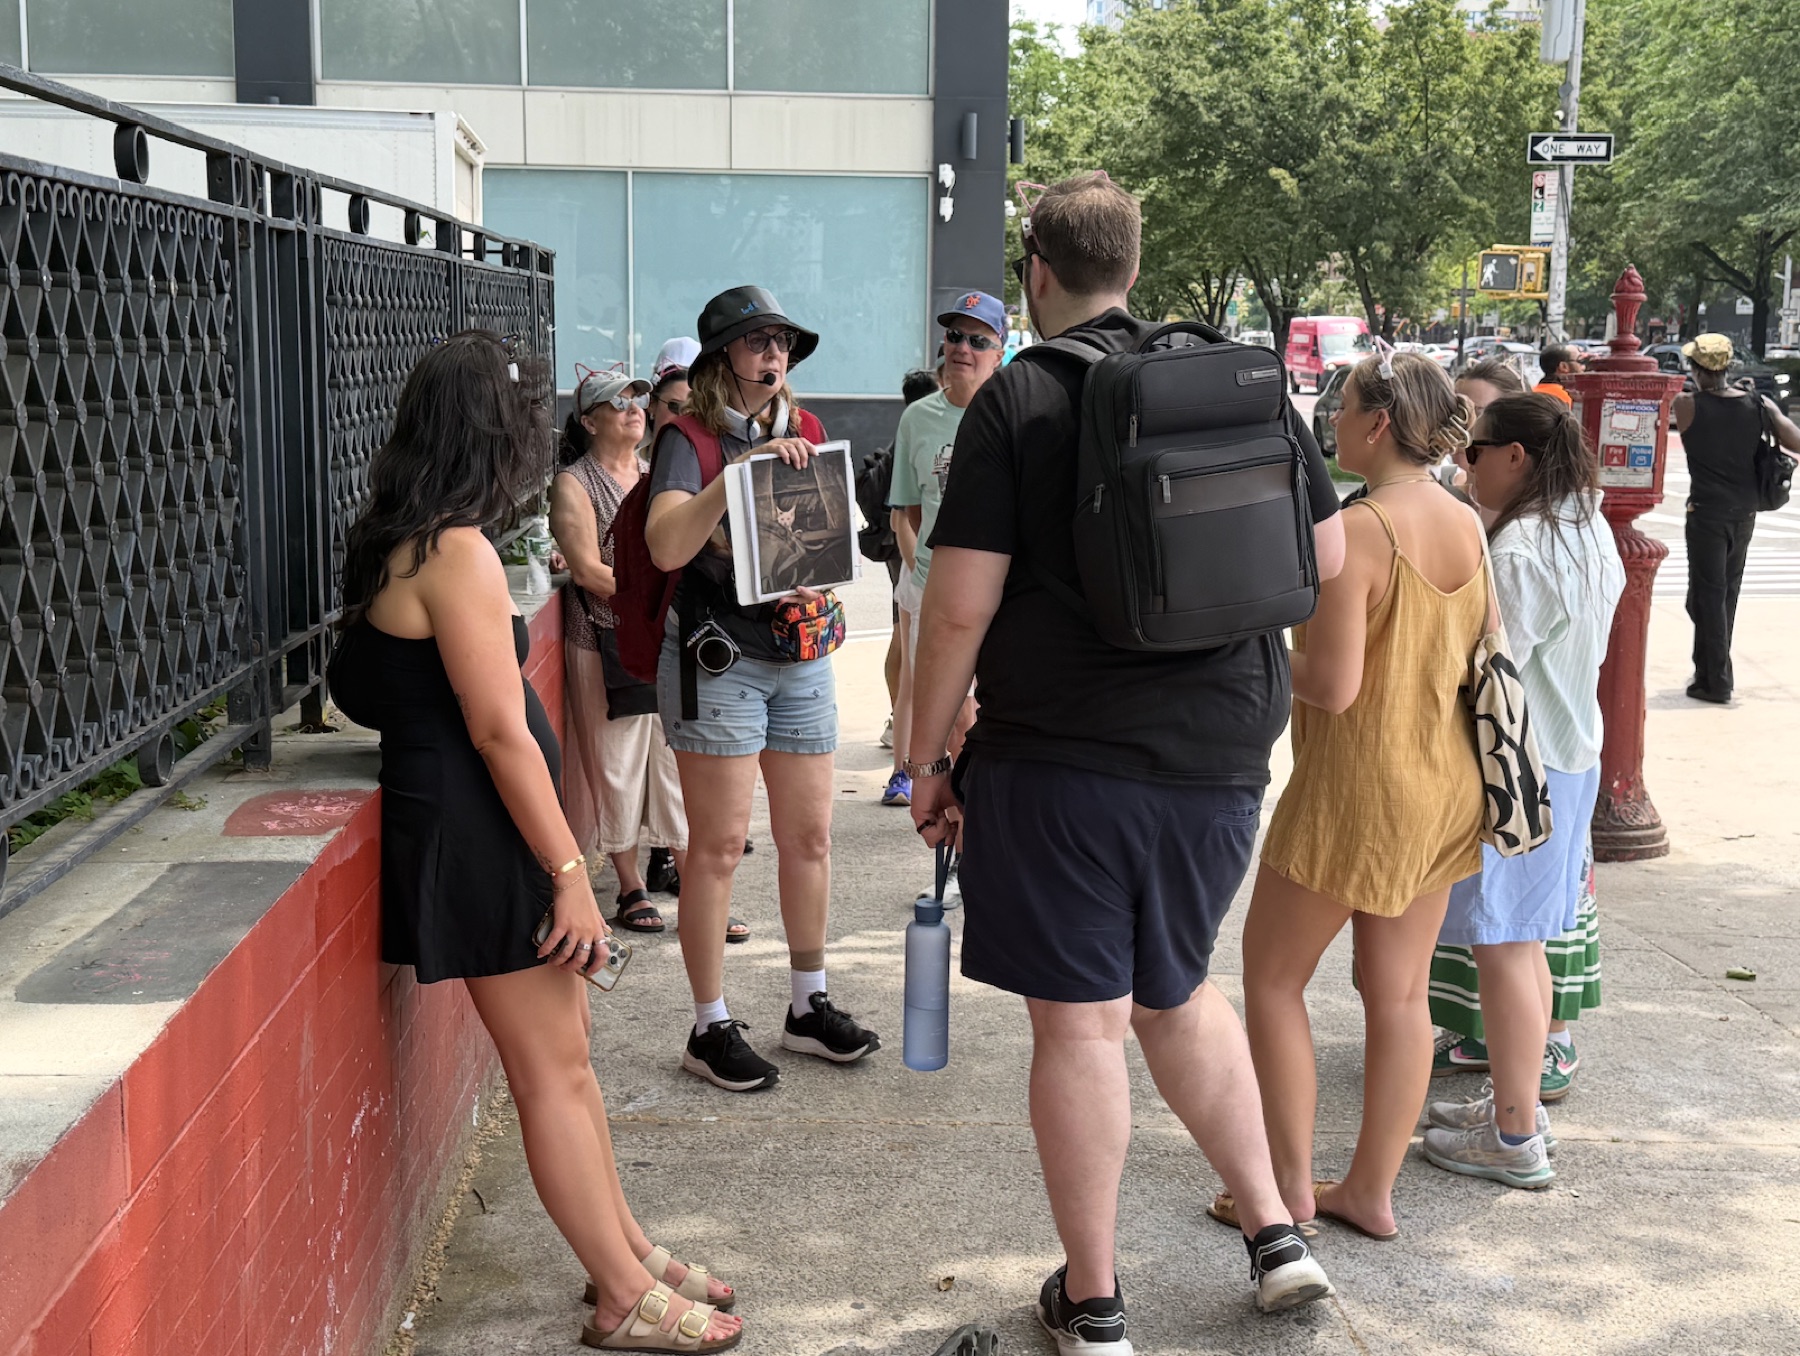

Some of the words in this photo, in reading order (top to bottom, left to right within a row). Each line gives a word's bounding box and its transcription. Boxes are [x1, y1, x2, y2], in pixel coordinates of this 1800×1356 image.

[1541, 143, 1565, 154] ONE
[1576, 143, 1601, 154] WAY
[1609, 447, 1623, 455] Fire
